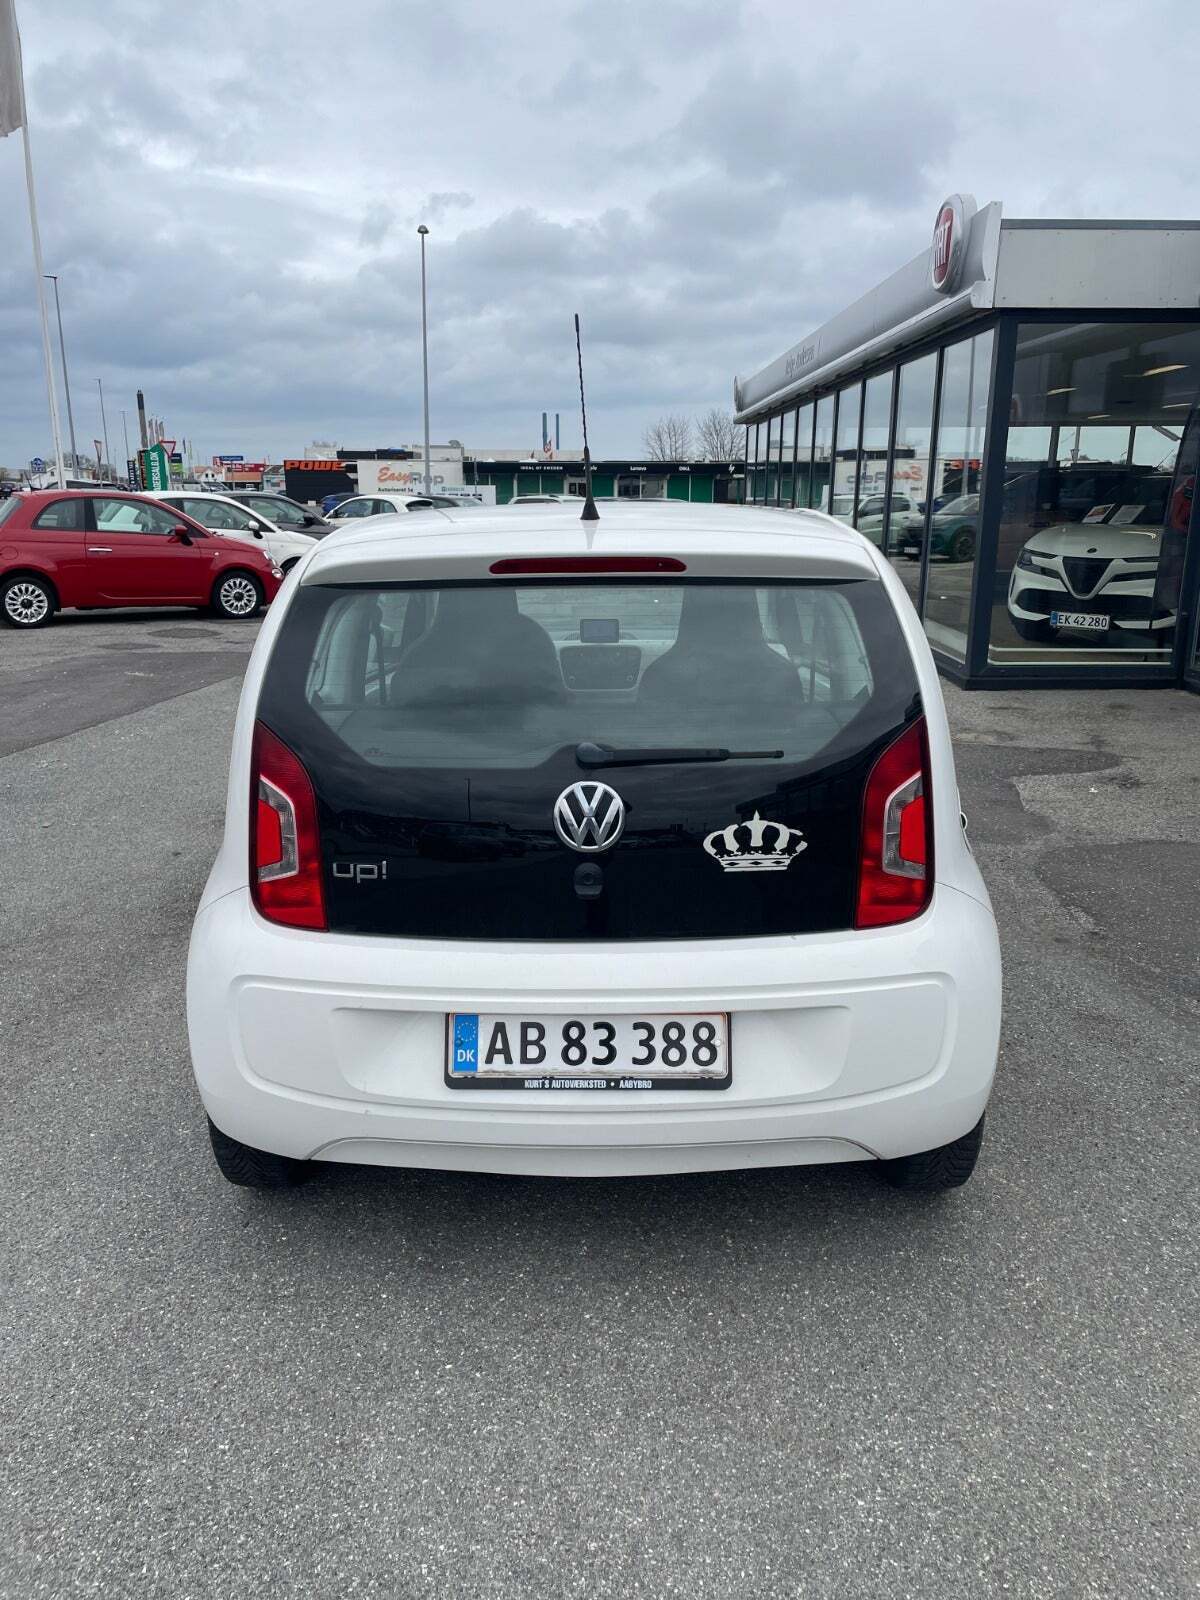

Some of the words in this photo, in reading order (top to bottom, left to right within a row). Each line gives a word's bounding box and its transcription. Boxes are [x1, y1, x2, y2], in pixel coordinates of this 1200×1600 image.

[1058, 614, 1071, 625] EK
[1073, 615, 1086, 626] 42
[1088, 616, 1107, 628] 280
[333, 861, 387, 883] up!
[484, 1021, 547, 1065] AB
[560, 1021, 618, 1066] 83
[631, 1021, 718, 1067] 388
[457, 1049, 475, 1063] DK
[619, 1079, 652, 1089] AABYBRO
